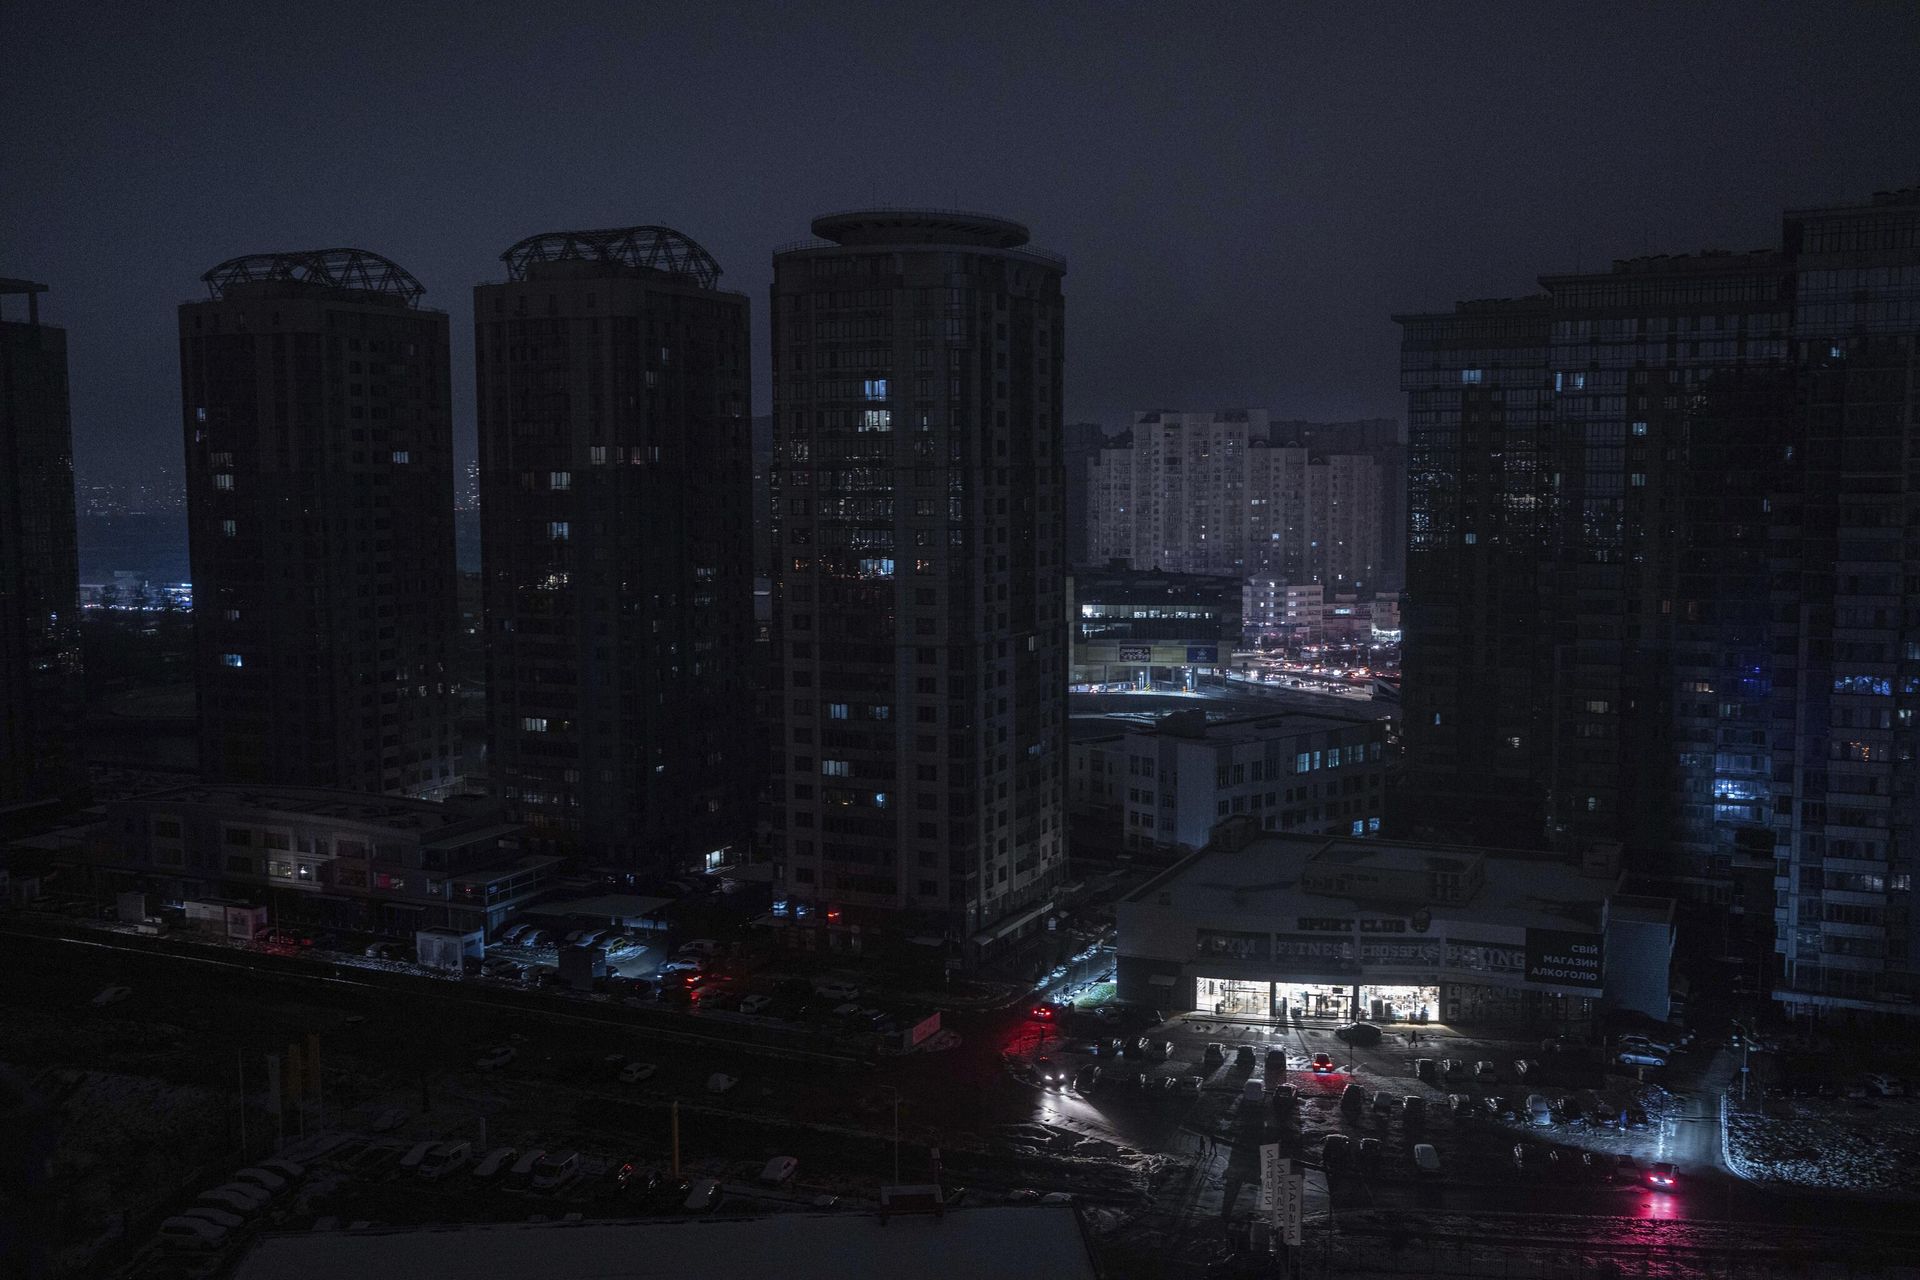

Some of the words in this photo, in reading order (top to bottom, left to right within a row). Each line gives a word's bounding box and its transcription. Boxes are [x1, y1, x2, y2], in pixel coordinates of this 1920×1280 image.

[1298, 917, 1355, 931] SPORT
[1360, 919, 1406, 933] CLUB
[1211, 935, 1256, 954] GYM
[1571, 944, 1598, 955] СВІЙ
[1446, 947, 1525, 969] BING
[1543, 955, 1598, 968] МАГАЗИН
[1531, 967, 1598, 981] АЛКОГОЛЮ
